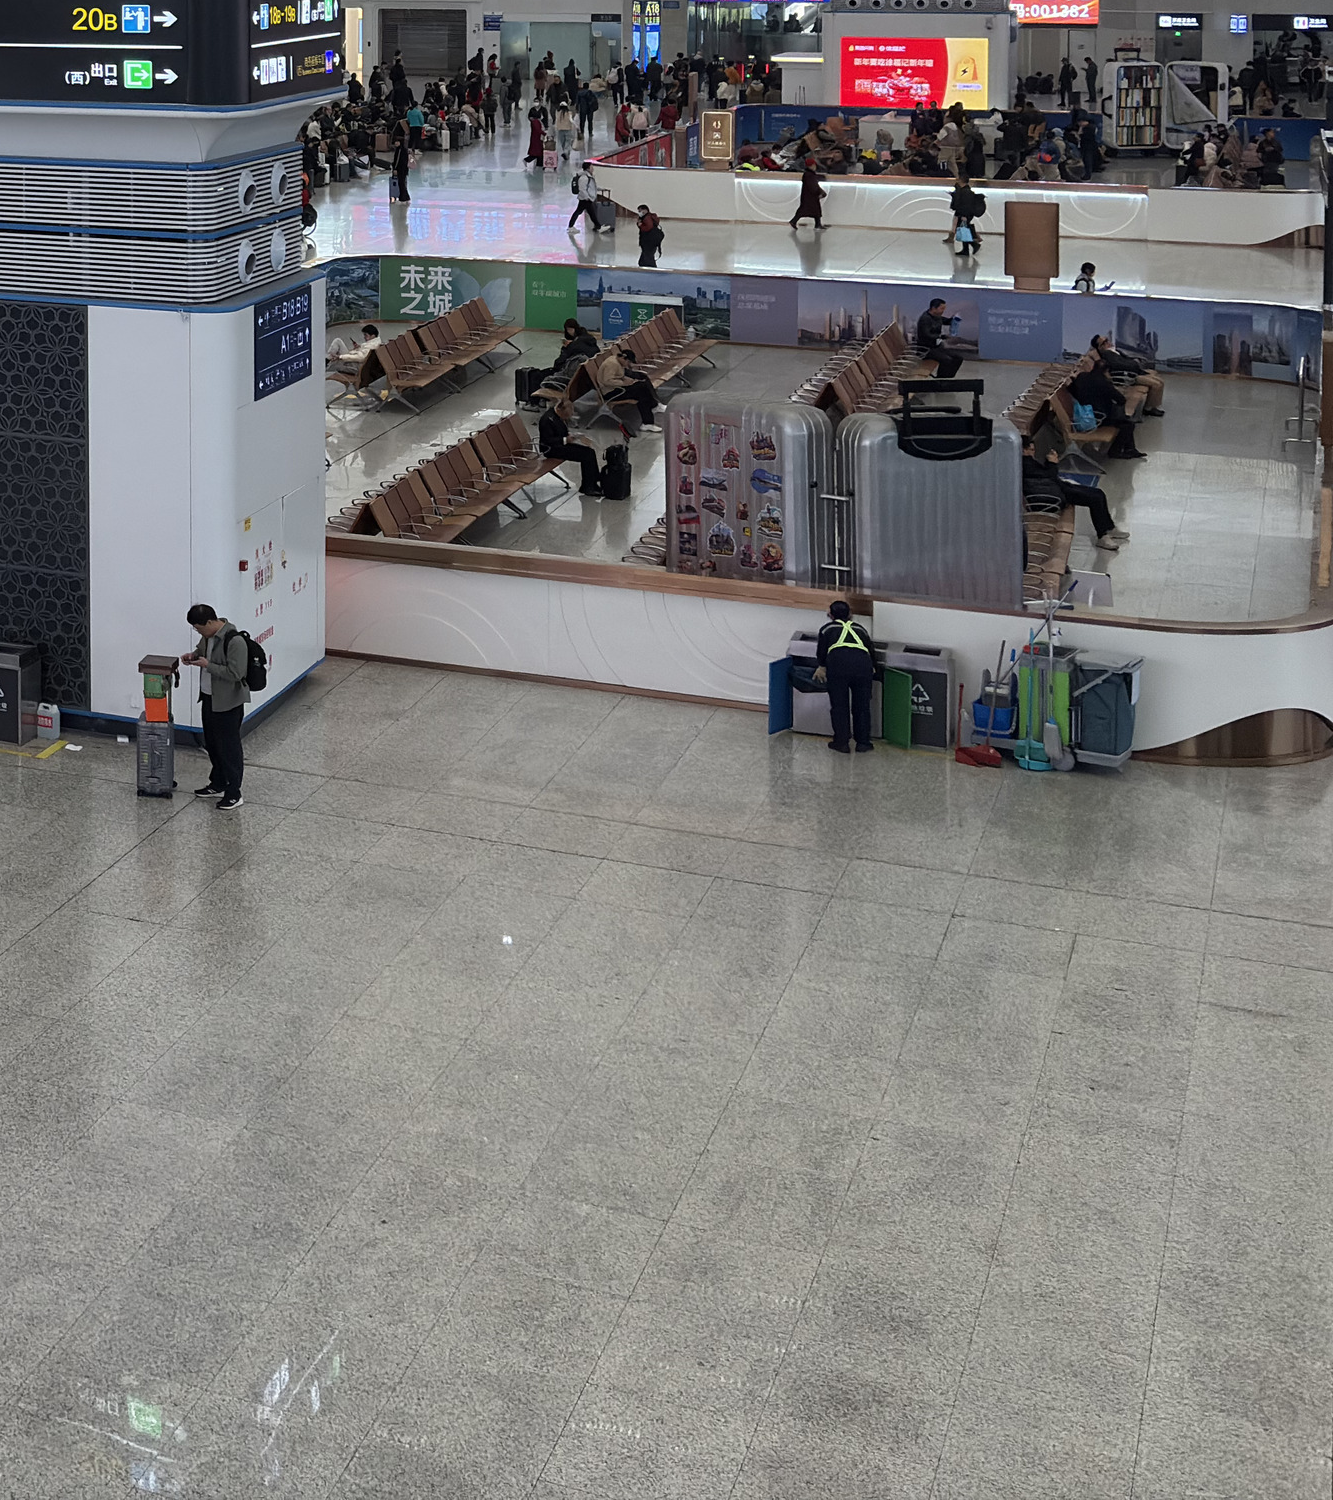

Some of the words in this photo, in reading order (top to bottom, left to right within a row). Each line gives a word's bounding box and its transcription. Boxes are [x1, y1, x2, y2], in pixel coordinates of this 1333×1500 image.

[71, 7, 118, 31] 20B
[269, 5, 296, 25] 18B-19B
[645, 4, 660, 14] A18
[64, 70, 91, 85] (西)
[91, 63, 118, 78] 出口
[400, 264, 453, 291] 未来
[400, 291, 453, 316] 之城
[280, 333, 290, 354] A1
